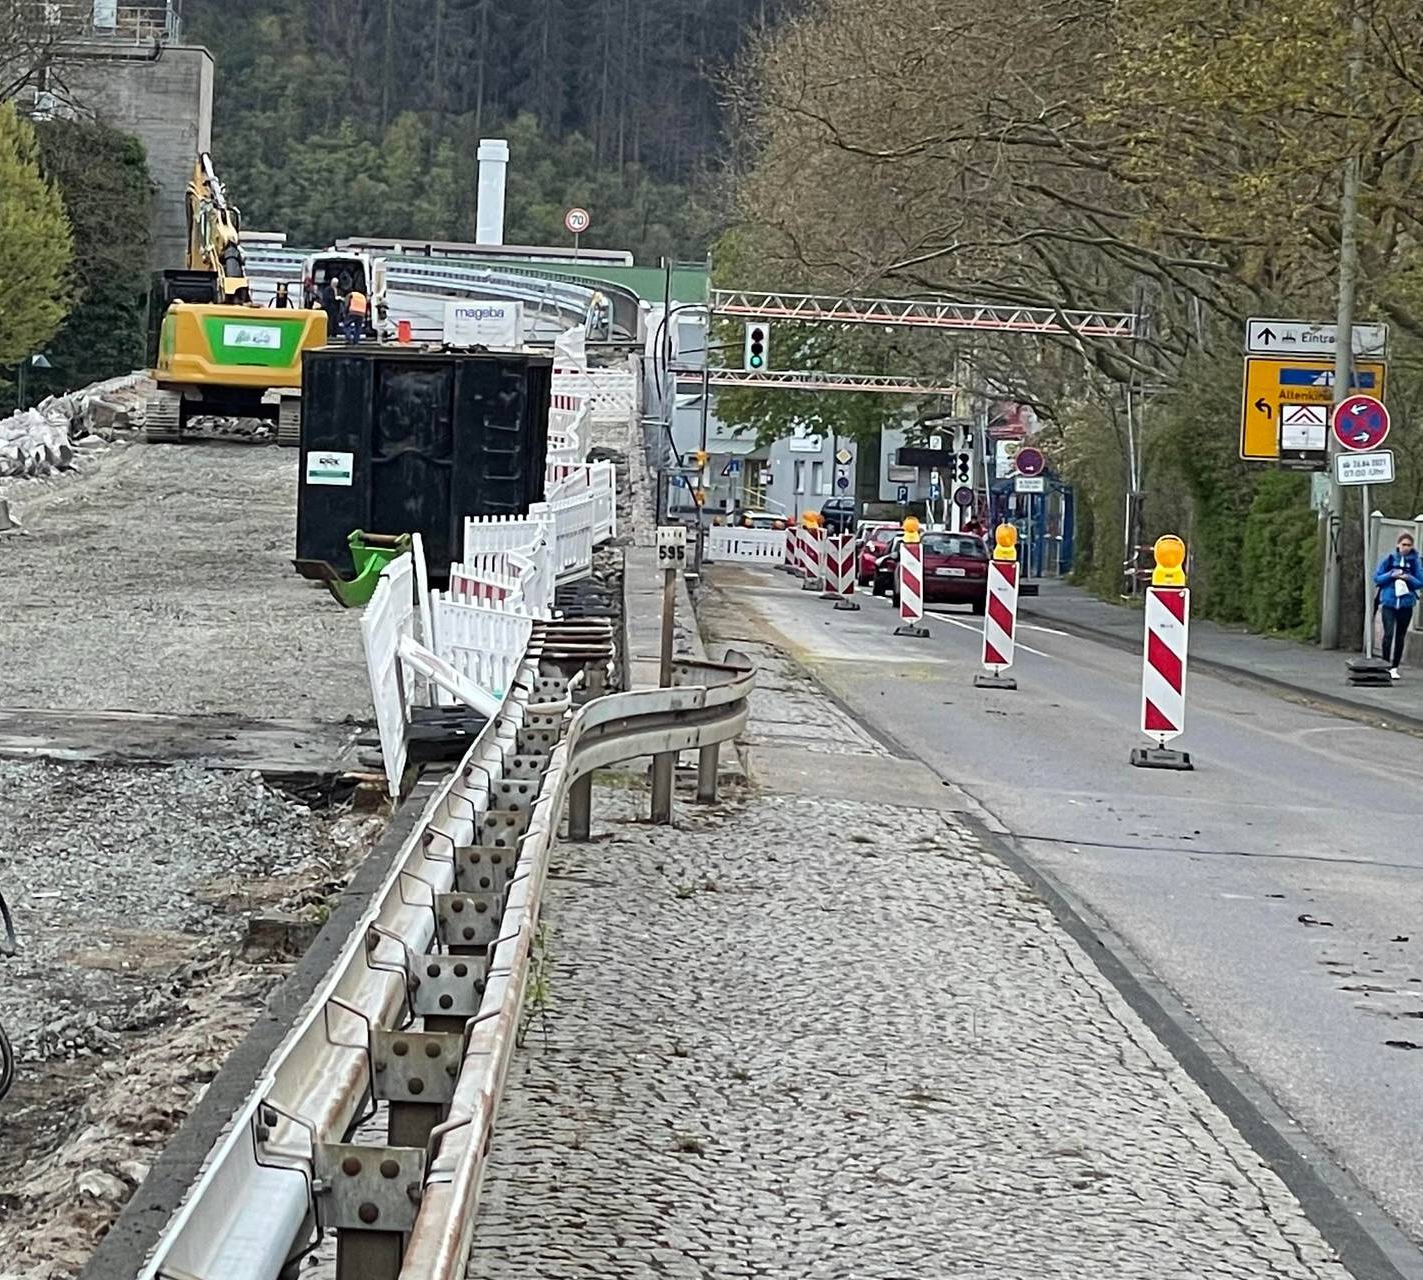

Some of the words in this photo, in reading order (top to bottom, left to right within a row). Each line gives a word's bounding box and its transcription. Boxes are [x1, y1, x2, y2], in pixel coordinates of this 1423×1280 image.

[572, 215, 584, 226] 70
[455, 307, 504, 320] mageba
[1301, 330, 1337, 344] Eintra
[659, 544, 685, 561] 595
